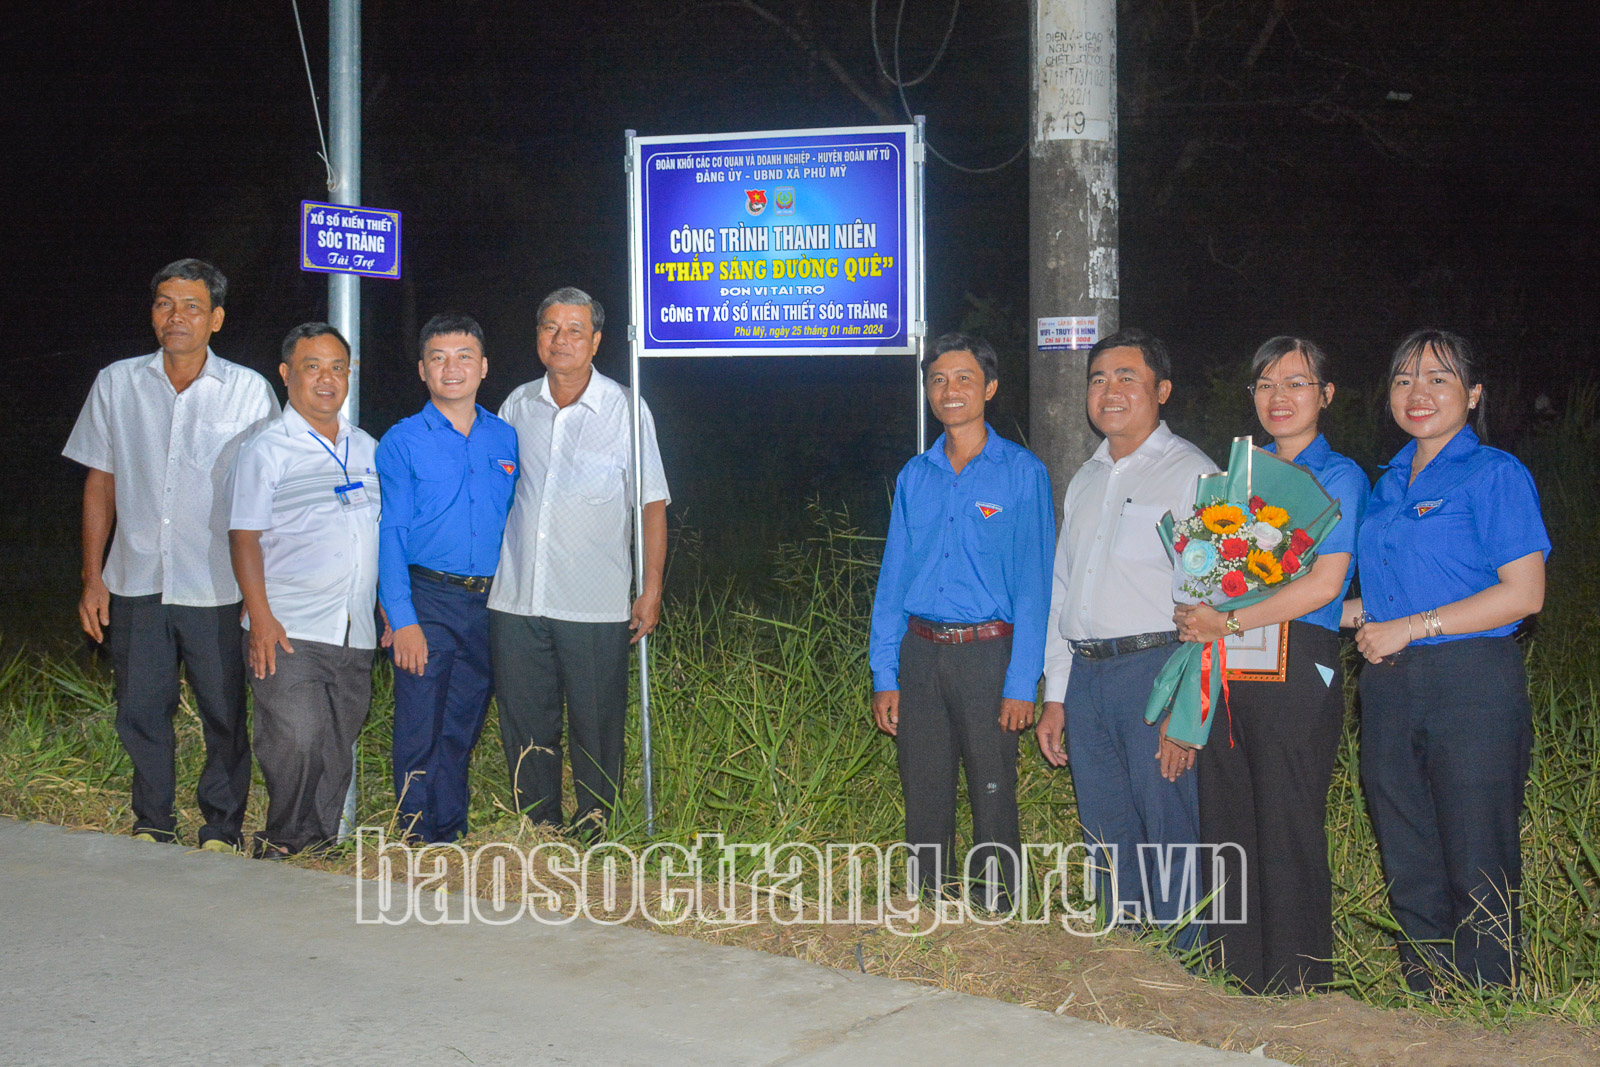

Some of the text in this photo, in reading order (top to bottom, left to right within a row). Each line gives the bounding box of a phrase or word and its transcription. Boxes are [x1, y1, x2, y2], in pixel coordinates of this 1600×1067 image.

[1063, 111, 1086, 134] 19
[656, 157, 676, 170] ĐOÀN
[677, 155, 694, 169] KHỐI
[696, 155, 710, 168] CÁC
[712, 156, 722, 168] CƠ
[724, 156, 744, 168] QUAN
[745, 153, 755, 166] VÀ
[757, 154, 782, 166] DOANH
[784, 150, 810, 166] NGHIỆP
[818, 149, 842, 164] HUYỆN
[844, 148, 864, 162] ĐOÀN
[866, 148, 878, 161] MỸ
[880, 146, 890, 160] TÚ
[696, 169, 725, 183] ĐẢNG
[728, 168, 742, 182] ỦY
[754, 169, 783, 180] UBND
[786, 166, 800, 179] XÃ
[803, 165, 826, 178] PHÚ
[830, 164, 847, 178] MỸ
[310, 210, 392, 232] XỔ SỐ KIẾN THIẾT
[318, 228, 385, 253] SÓC TRĂNG
[670, 218, 876, 254] CÔNG TRÌNH THANH NIÊN
[328, 252, 375, 270] Tài Trợ
[719, 256, 767, 280] SÁNG
[772, 254, 838, 279] ĐƯỜNG
[720, 287, 751, 296] ĐƠN
[661, 299, 888, 323] CÔNG TY XỔ SỐ KIẾN THIẾT SÓC TRĂNG
[734, 326, 751, 336] Phú
[769, 327, 790, 338] ngày
[792, 326, 802, 335] 25
[804, 325, 828, 338] tháng
[830, 325, 840, 335] 01
[842, 324, 861, 334] năm
[863, 324, 883, 334] 2024
